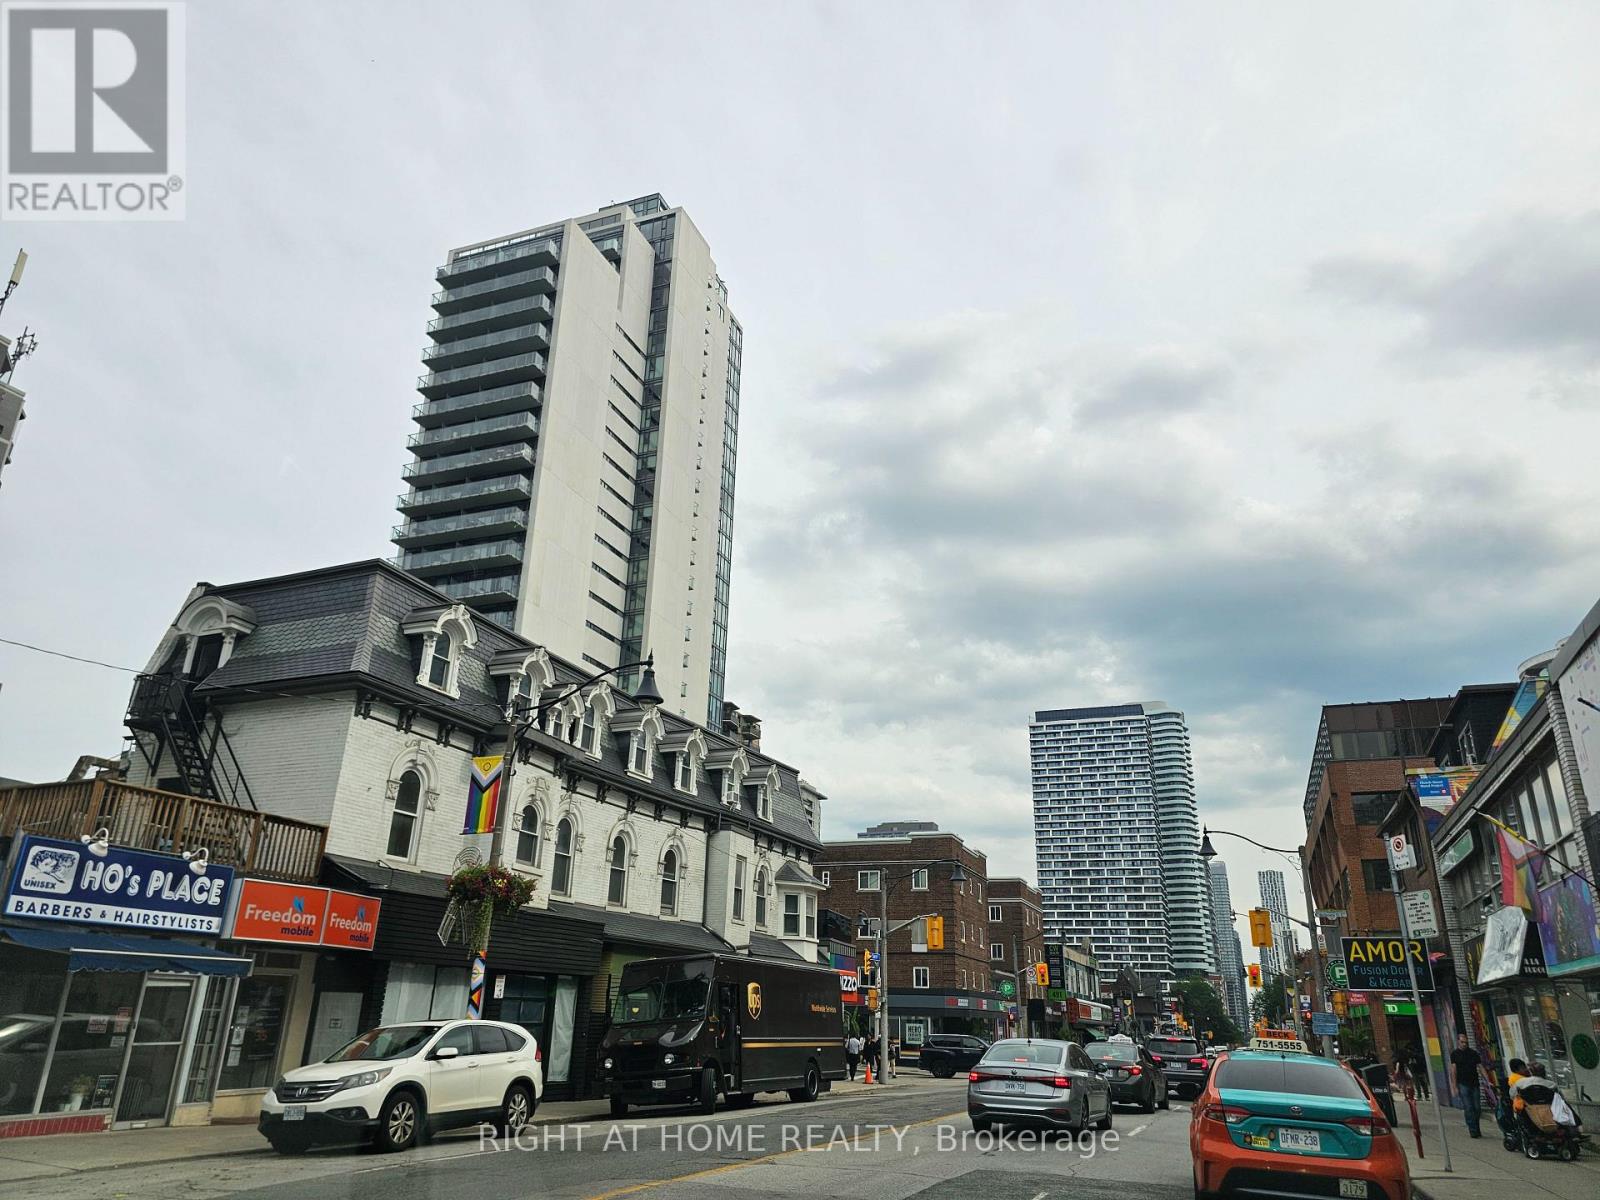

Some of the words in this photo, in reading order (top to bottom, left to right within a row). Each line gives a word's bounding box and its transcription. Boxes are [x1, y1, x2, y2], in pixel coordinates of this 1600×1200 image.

[24, 879, 57, 891] UNISEX
[146, 869, 225, 906] PLACE
[14, 900, 93, 919] BARBERS
[99, 909, 107, 919] &
[114, 910, 214, 931] HAIRSTYLISTS
[244, 903, 317, 926] Freedom
[329, 912, 372, 933] Freedom
[280, 924, 314, 937] mobile
[349, 932, 370, 943] mobile
[1349, 940, 1425, 963] AMOR
[1334, 966, 1347, 979] P
[1384, 1003, 1398, 1013] TD
[1266, 1030, 1290, 1039] BECK
[1256, 1039, 1303, 1051] 751-5555
[1342, 1183, 1365, 1195] 3179
